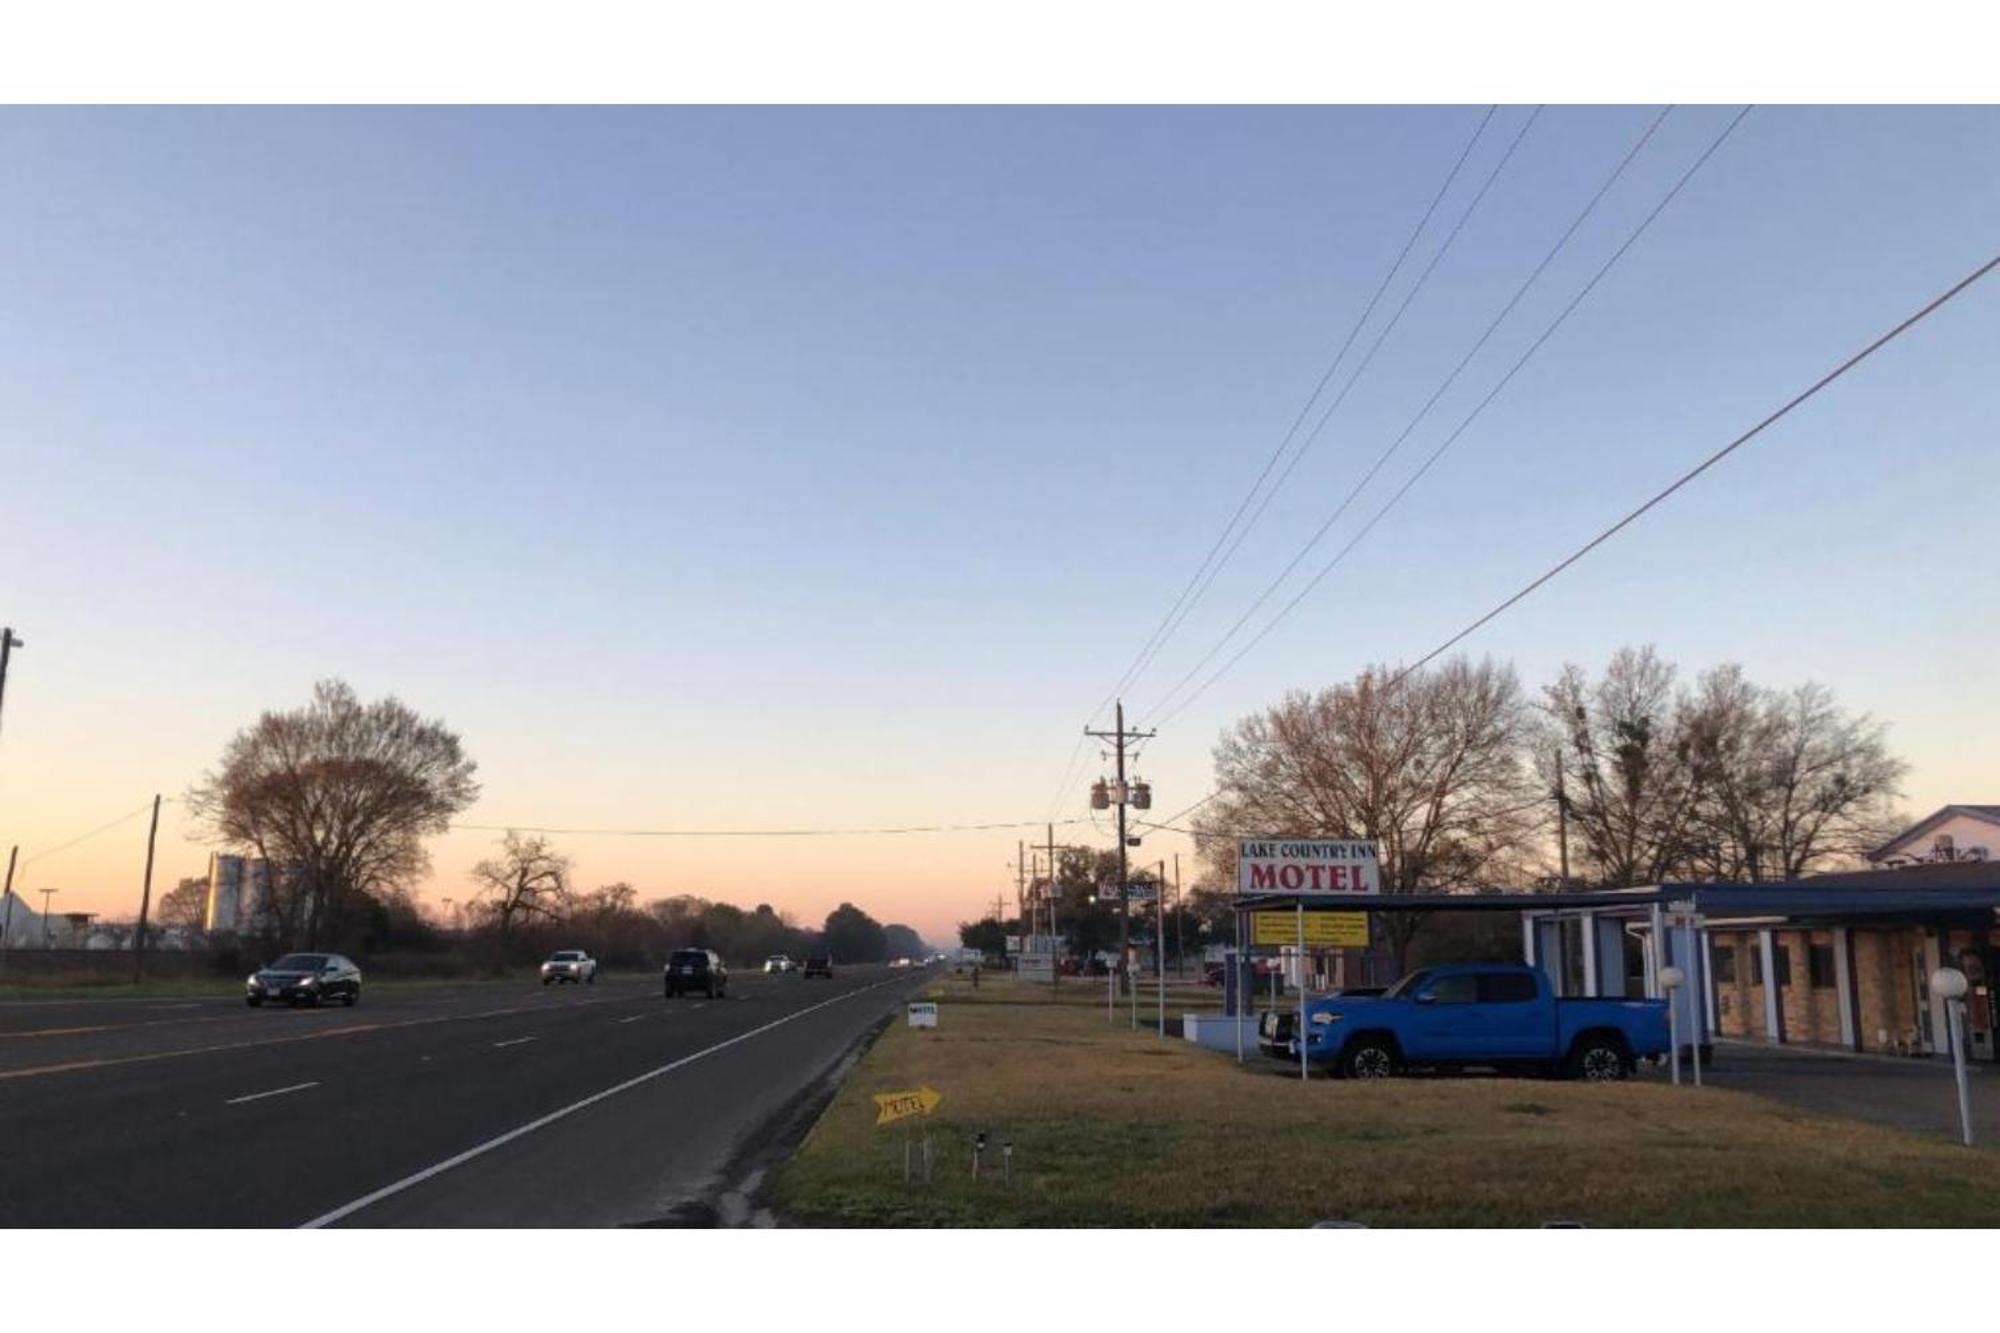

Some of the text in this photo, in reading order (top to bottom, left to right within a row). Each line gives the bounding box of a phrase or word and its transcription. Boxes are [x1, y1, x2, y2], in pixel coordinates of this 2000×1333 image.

[1241, 842, 1376, 860] LAKE COUNTRY INN
[1250, 863, 1369, 892] MOTEL
